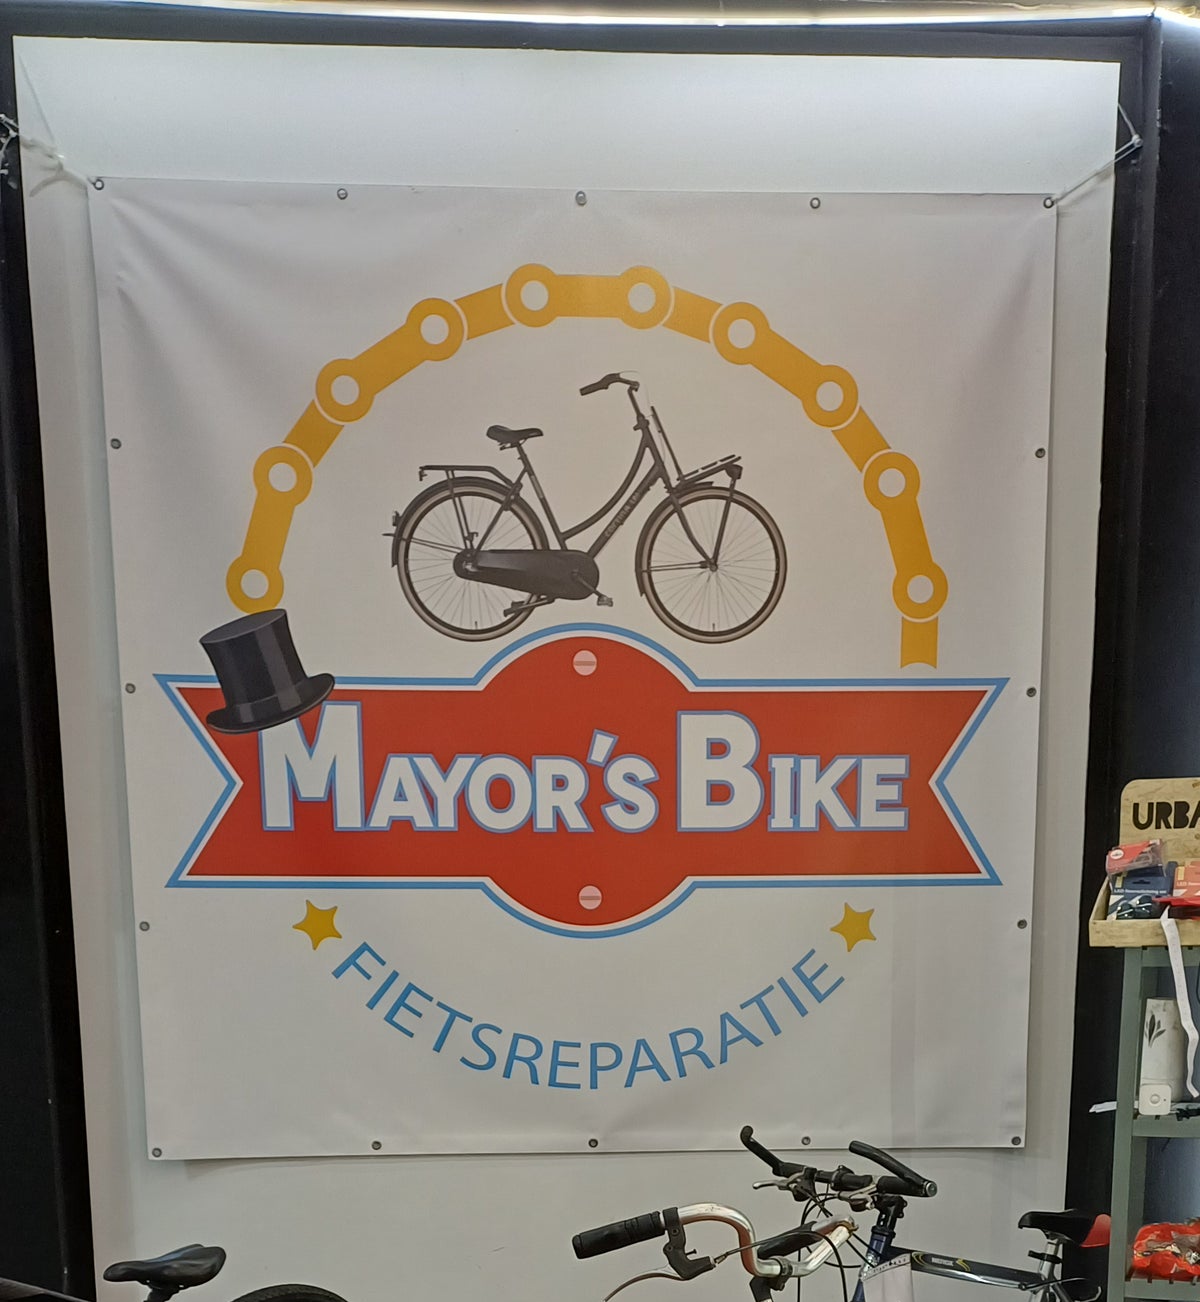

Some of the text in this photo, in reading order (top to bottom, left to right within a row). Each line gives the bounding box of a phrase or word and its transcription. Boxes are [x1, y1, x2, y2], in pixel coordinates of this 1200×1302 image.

[258, 700, 911, 834] MAYOR'S BIKE
[331, 941, 845, 1089] FIETSREPARATIE
